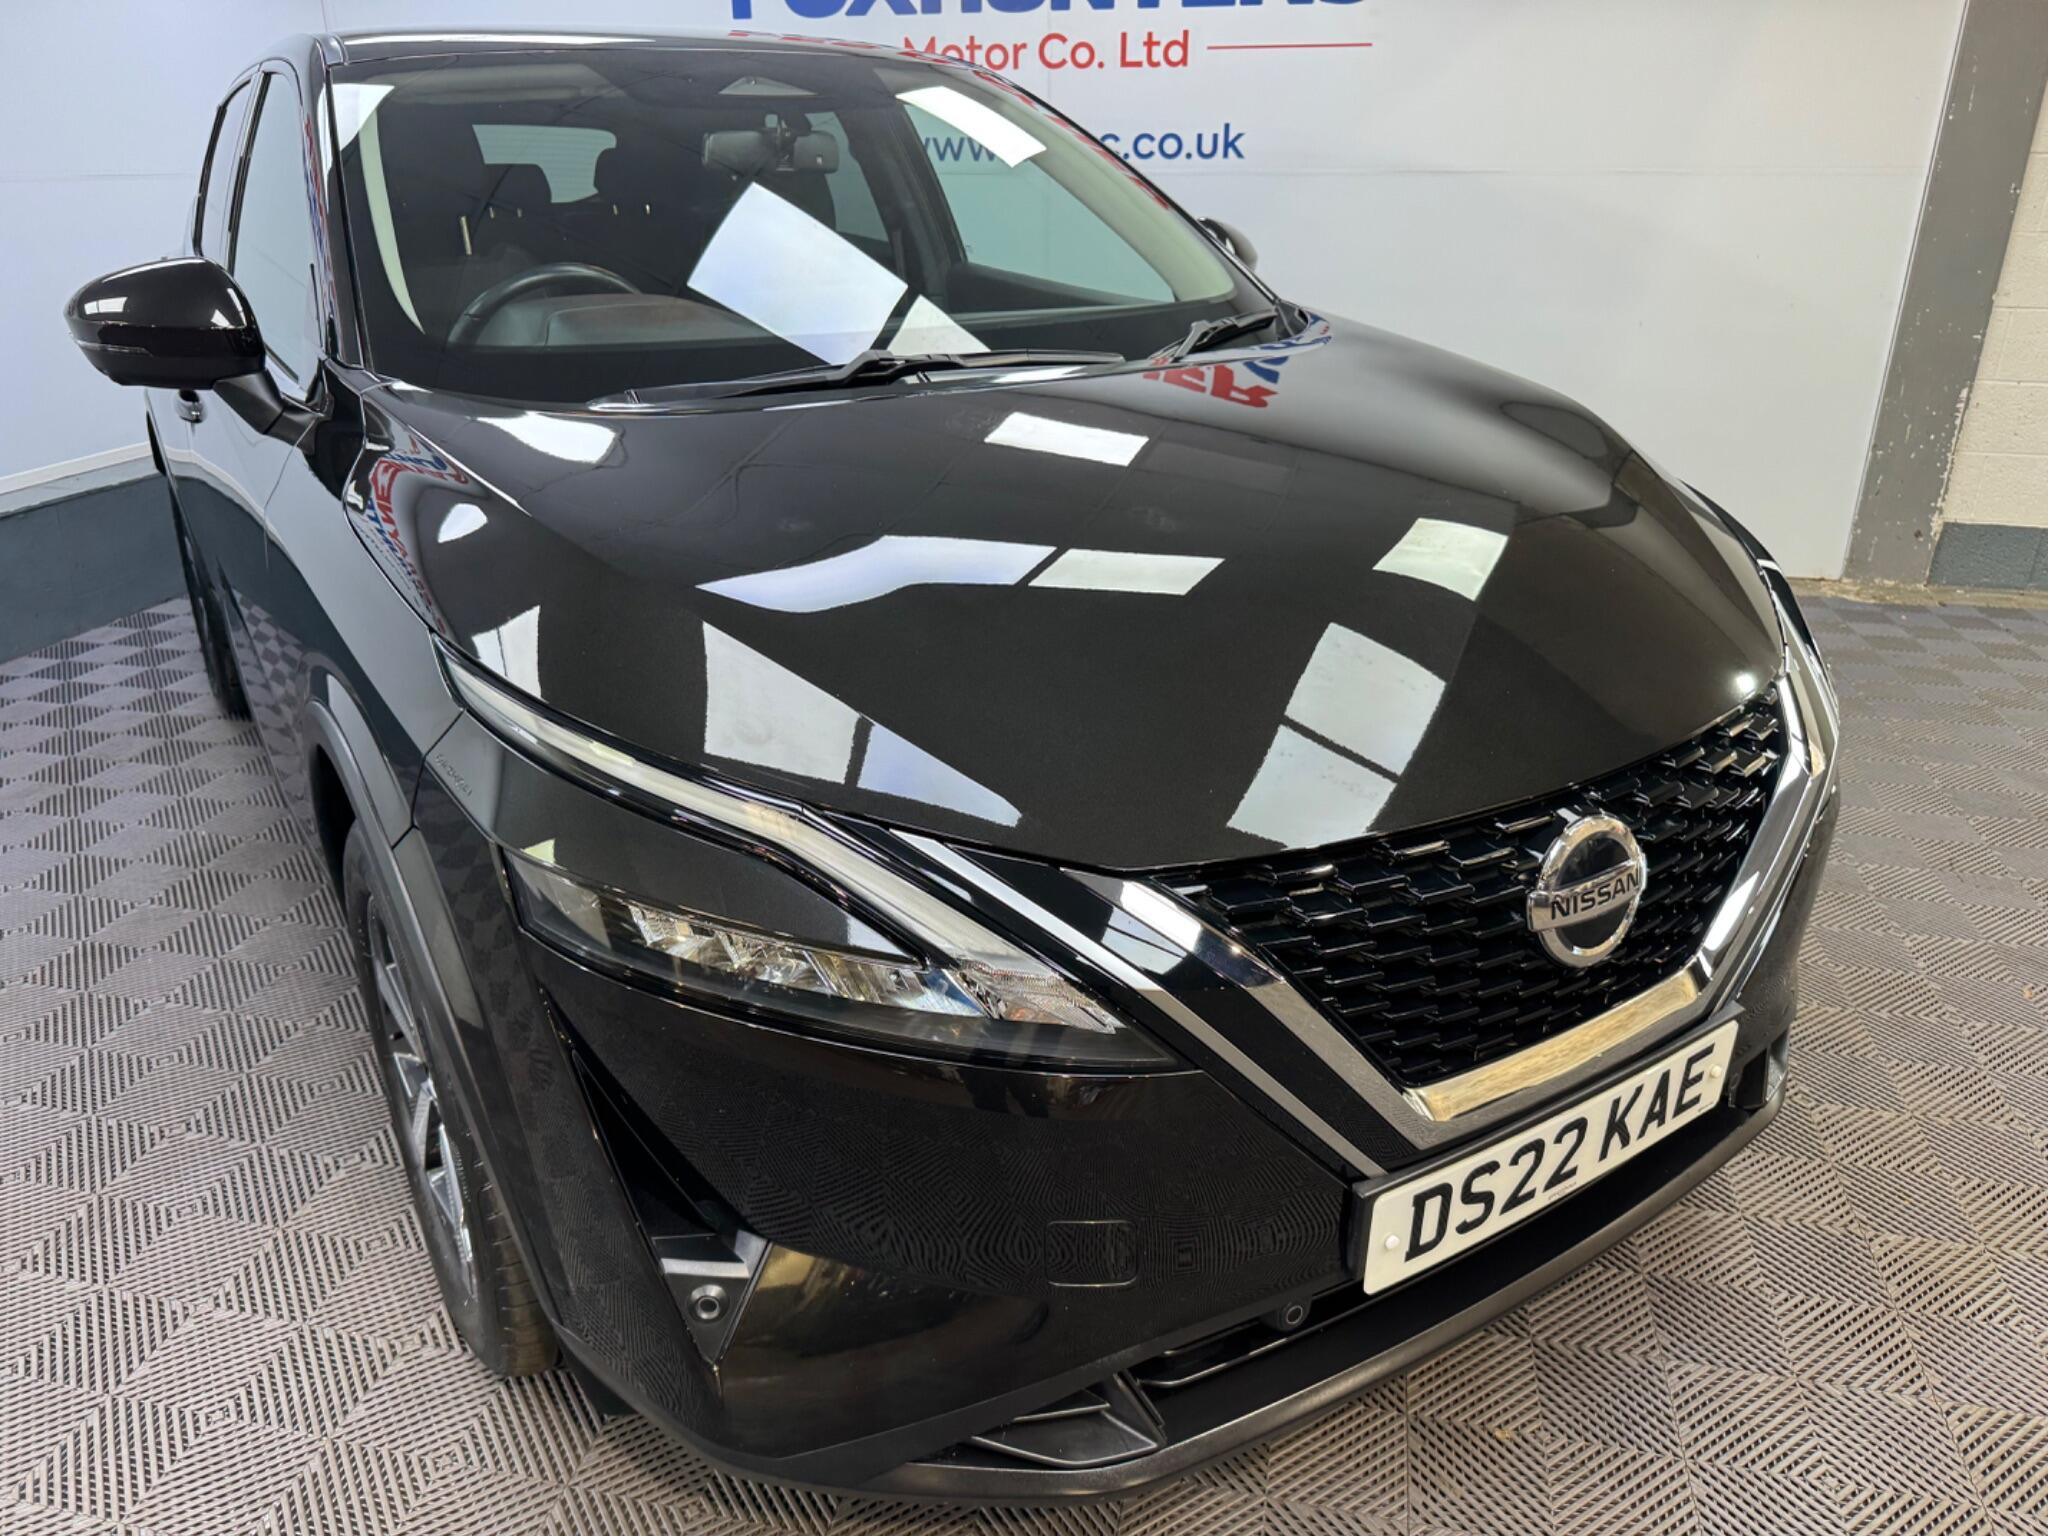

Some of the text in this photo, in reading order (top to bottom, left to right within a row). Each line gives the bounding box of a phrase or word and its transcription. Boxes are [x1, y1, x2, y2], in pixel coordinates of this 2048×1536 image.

[1038, 33, 1105, 69] Co.
[1119, 29, 1190, 68] Ltd
[1551, 868, 1639, 920] NISSAN
[1404, 1044, 1716, 1262] DS22 KAE
